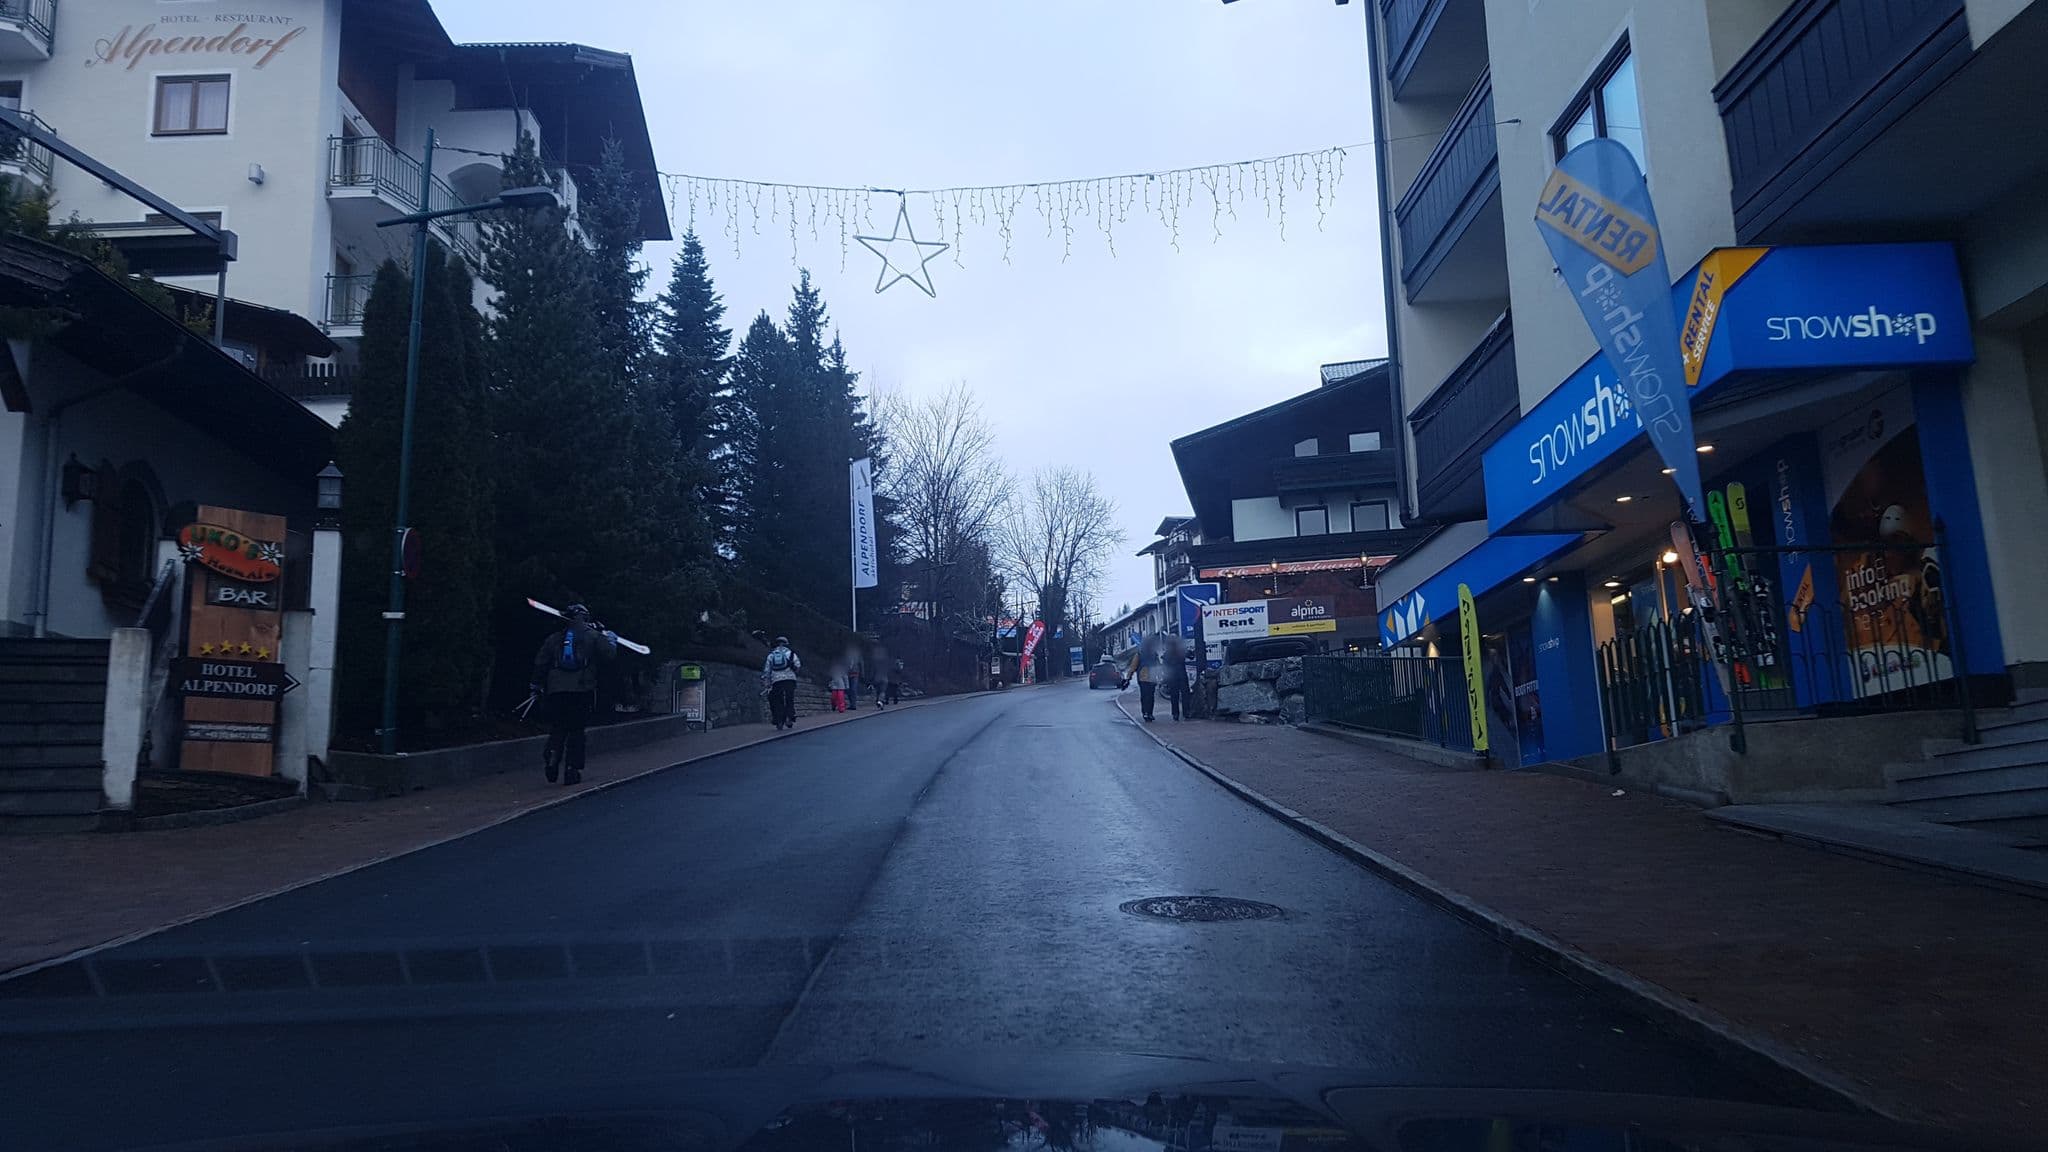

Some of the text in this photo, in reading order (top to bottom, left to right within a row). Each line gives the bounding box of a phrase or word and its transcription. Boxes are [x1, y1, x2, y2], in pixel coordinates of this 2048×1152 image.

[160, 15, 199, 23] HOTEL
[214, 14, 293, 25] RESTAURANT
[84, 23, 307, 70] Alpendorf
[1684, 271, 1714, 351] RENTAL
[1693, 299, 1716, 363] SERVICE
[1529, 374, 1643, 484] snowsho
[858, 501, 869, 576] ALPENDORF
[1845, 565, 1875, 591] info
[219, 587, 269, 606] BAR
[1848, 580, 1911, 612] booking
[1213, 606, 1265, 617] INTERSPORT
[1219, 617, 1255, 628] Rent
[1291, 603, 1325, 620] alpina
[202, 663, 257, 678] HOTEL
[180, 679, 278, 696] ALPENDORF
